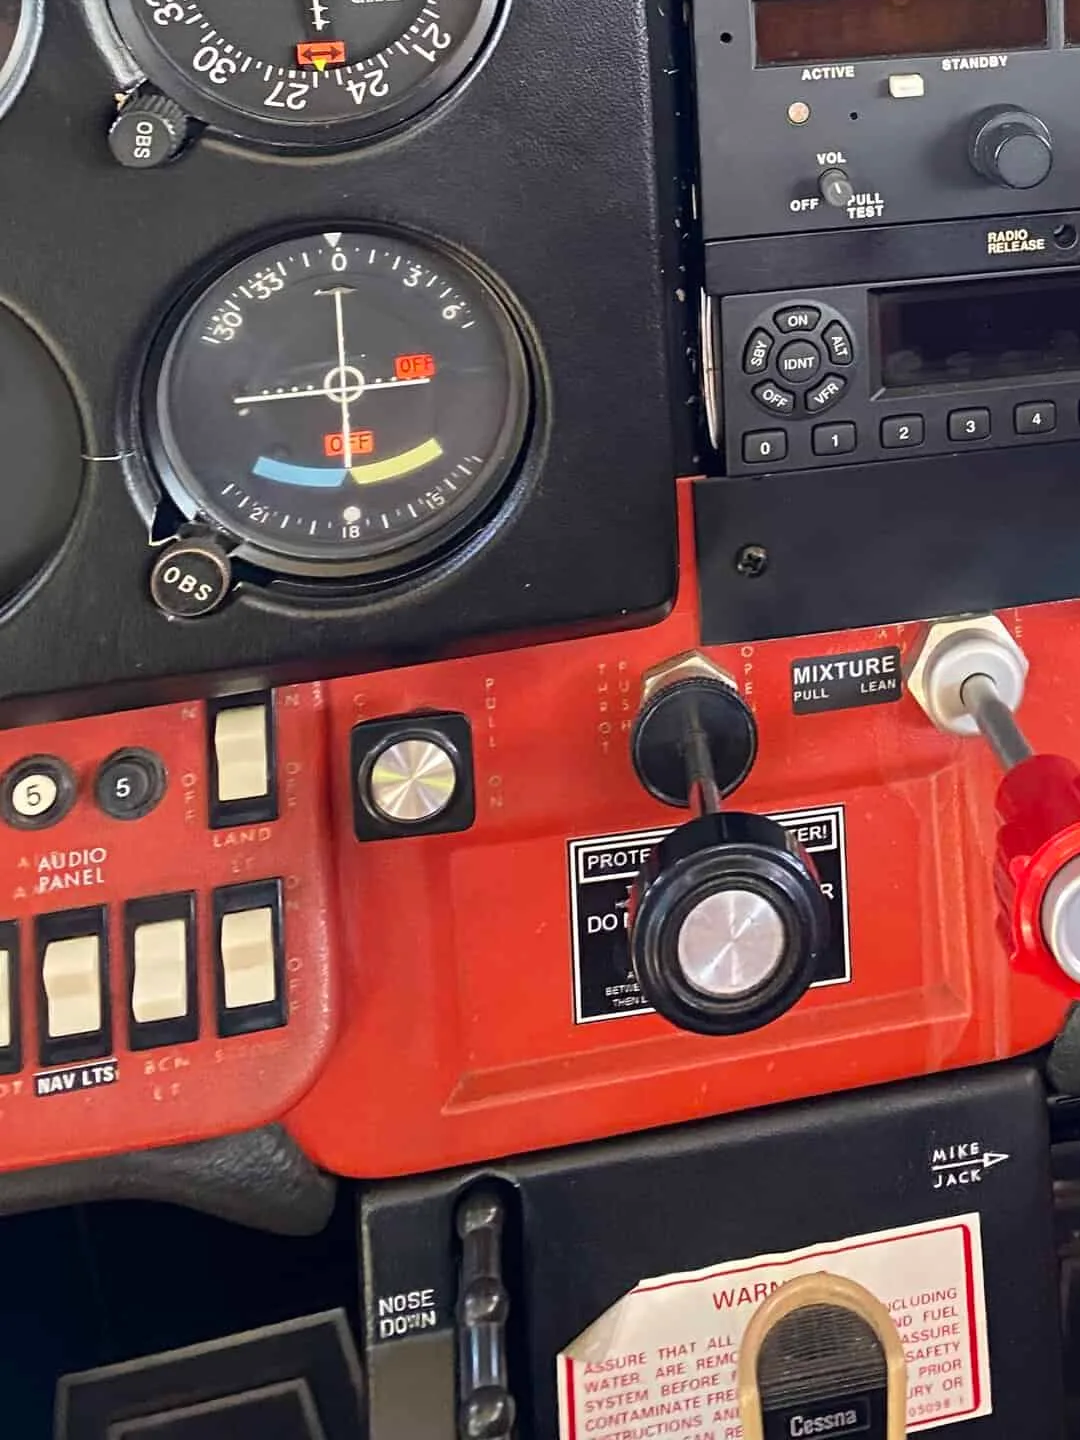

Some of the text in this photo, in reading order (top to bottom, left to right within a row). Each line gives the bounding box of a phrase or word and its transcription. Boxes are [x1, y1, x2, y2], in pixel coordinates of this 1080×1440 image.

[942, 55, 1008, 71] STANDBY
[801, 66, 855, 81] ACTIVE
[134, 120, 152, 160] OBS
[790, 198, 819, 211] OFF
[987, 229, 1029, 243] RADIO
[987, 239, 1045, 254] RELEASE
[787, 315, 808, 326] ON
[399, 357, 434, 374] OFF
[784, 356, 815, 371] IDNT
[760, 442, 770, 455] 0
[163, 567, 213, 602] OBS
[793, 655, 896, 685] MIXTURE
[794, 678, 897, 701] PULL LEAN
[116, 778, 130, 797] 5
[37, 847, 107, 873] AUDIO
[38, 867, 105, 895] PANEL
[37, 1065, 115, 1094] NAV LTS
[932, 1142, 980, 1163] MIKE
[933, 1169, 982, 1189] JACK
[378, 1288, 435, 1315] NOSE
[379, 1309, 437, 1336] DOWN
[584, 1335, 734, 1376] ASSURE THAT ALL
[918, 1358, 962, 1376] PRIOR
[790, 1409, 857, 1437] Cessna
